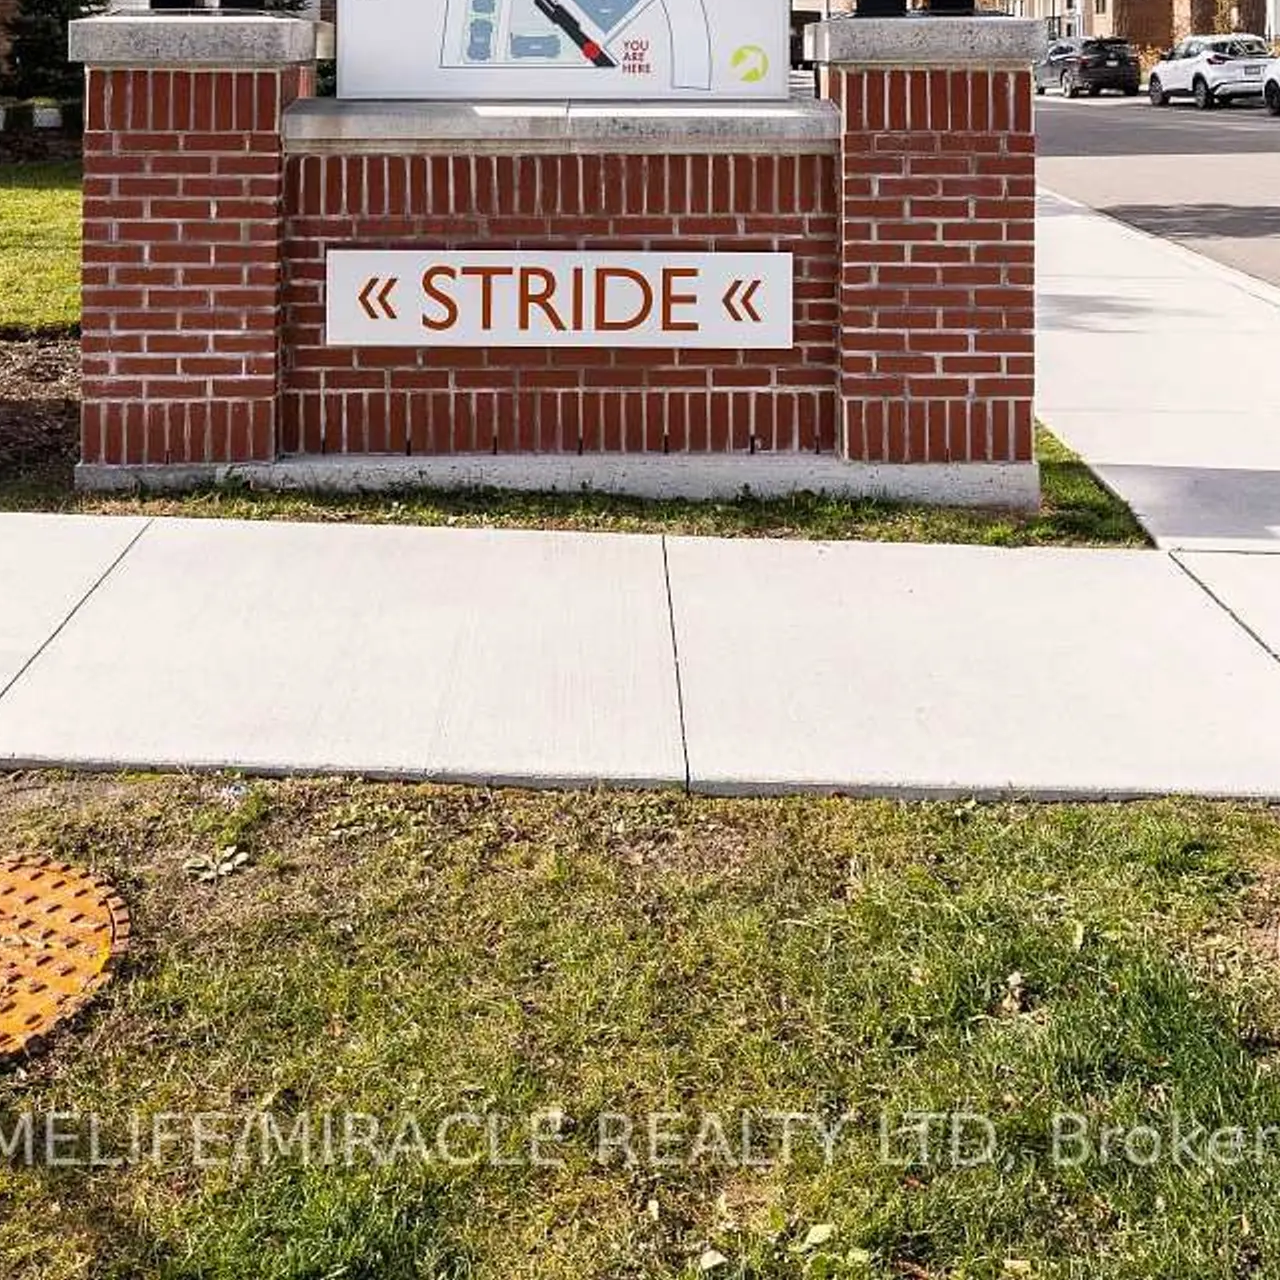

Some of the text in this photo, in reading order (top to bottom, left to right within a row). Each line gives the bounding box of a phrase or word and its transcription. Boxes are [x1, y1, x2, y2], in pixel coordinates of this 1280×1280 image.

[623, 40, 649, 51] YOU
[623, 52, 644, 61] ARE
[622, 64, 650, 73] HERE
[421, 266, 700, 331] STRIDE
